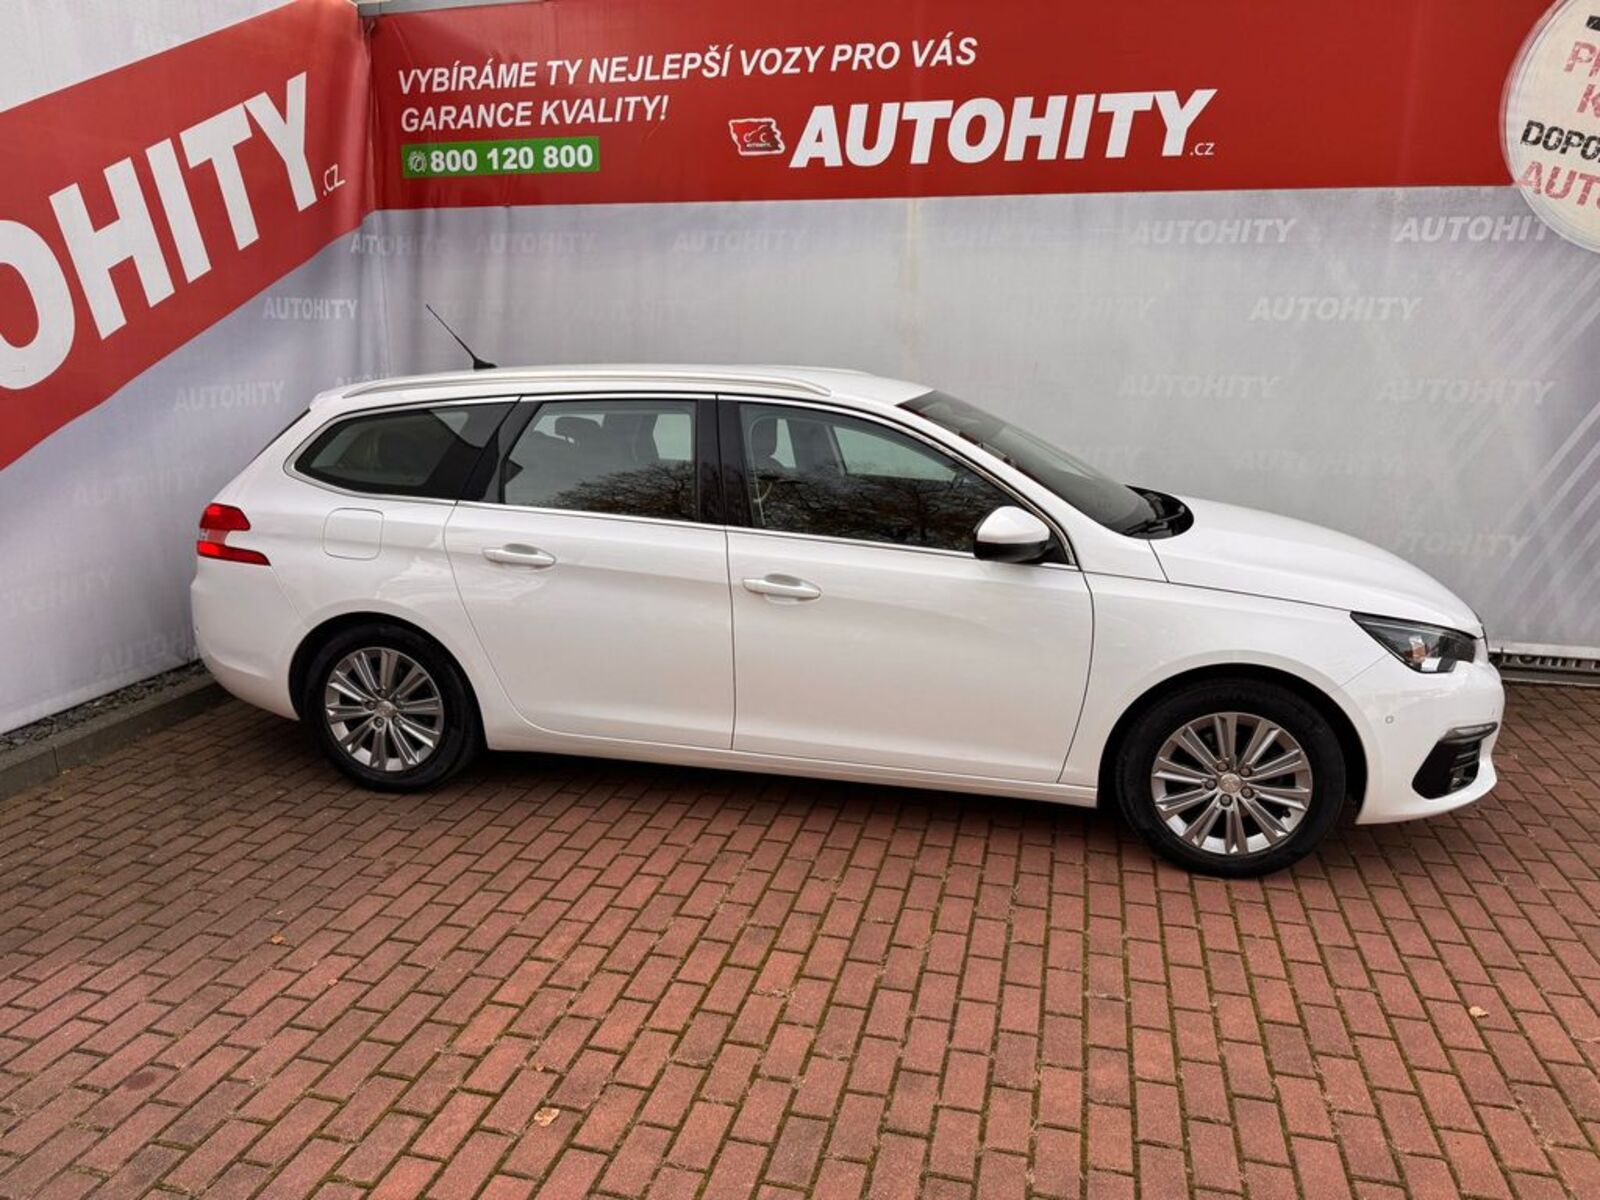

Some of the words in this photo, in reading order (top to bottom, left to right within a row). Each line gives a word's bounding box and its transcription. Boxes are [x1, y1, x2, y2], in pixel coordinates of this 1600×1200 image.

[399, 58, 538, 95] VYBÍRÁME
[546, 59, 583, 86] TY
[588, 44, 734, 84] NEJLEPŠÍ
[740, 45, 825, 76] VOZY
[830, 41, 901, 72] PRO
[911, 31, 978, 68] VÁS
[401, 101, 533, 133] GARANCE
[540, 95, 669, 126] KVALITY!
[1520, 119, 1600, 163] DOPO
[430, 150, 478, 172] 800
[487, 146, 534, 170] 120
[543, 144, 593, 168] 800
[1519, 161, 1600, 208] AUT
[1130, 218, 1297, 245] AUTOHITY
[262, 297, 358, 320] AUTOHITY
[1250, 297, 1421, 322] AUTOHITY
[174, 380, 285, 412] AUTOHITY
